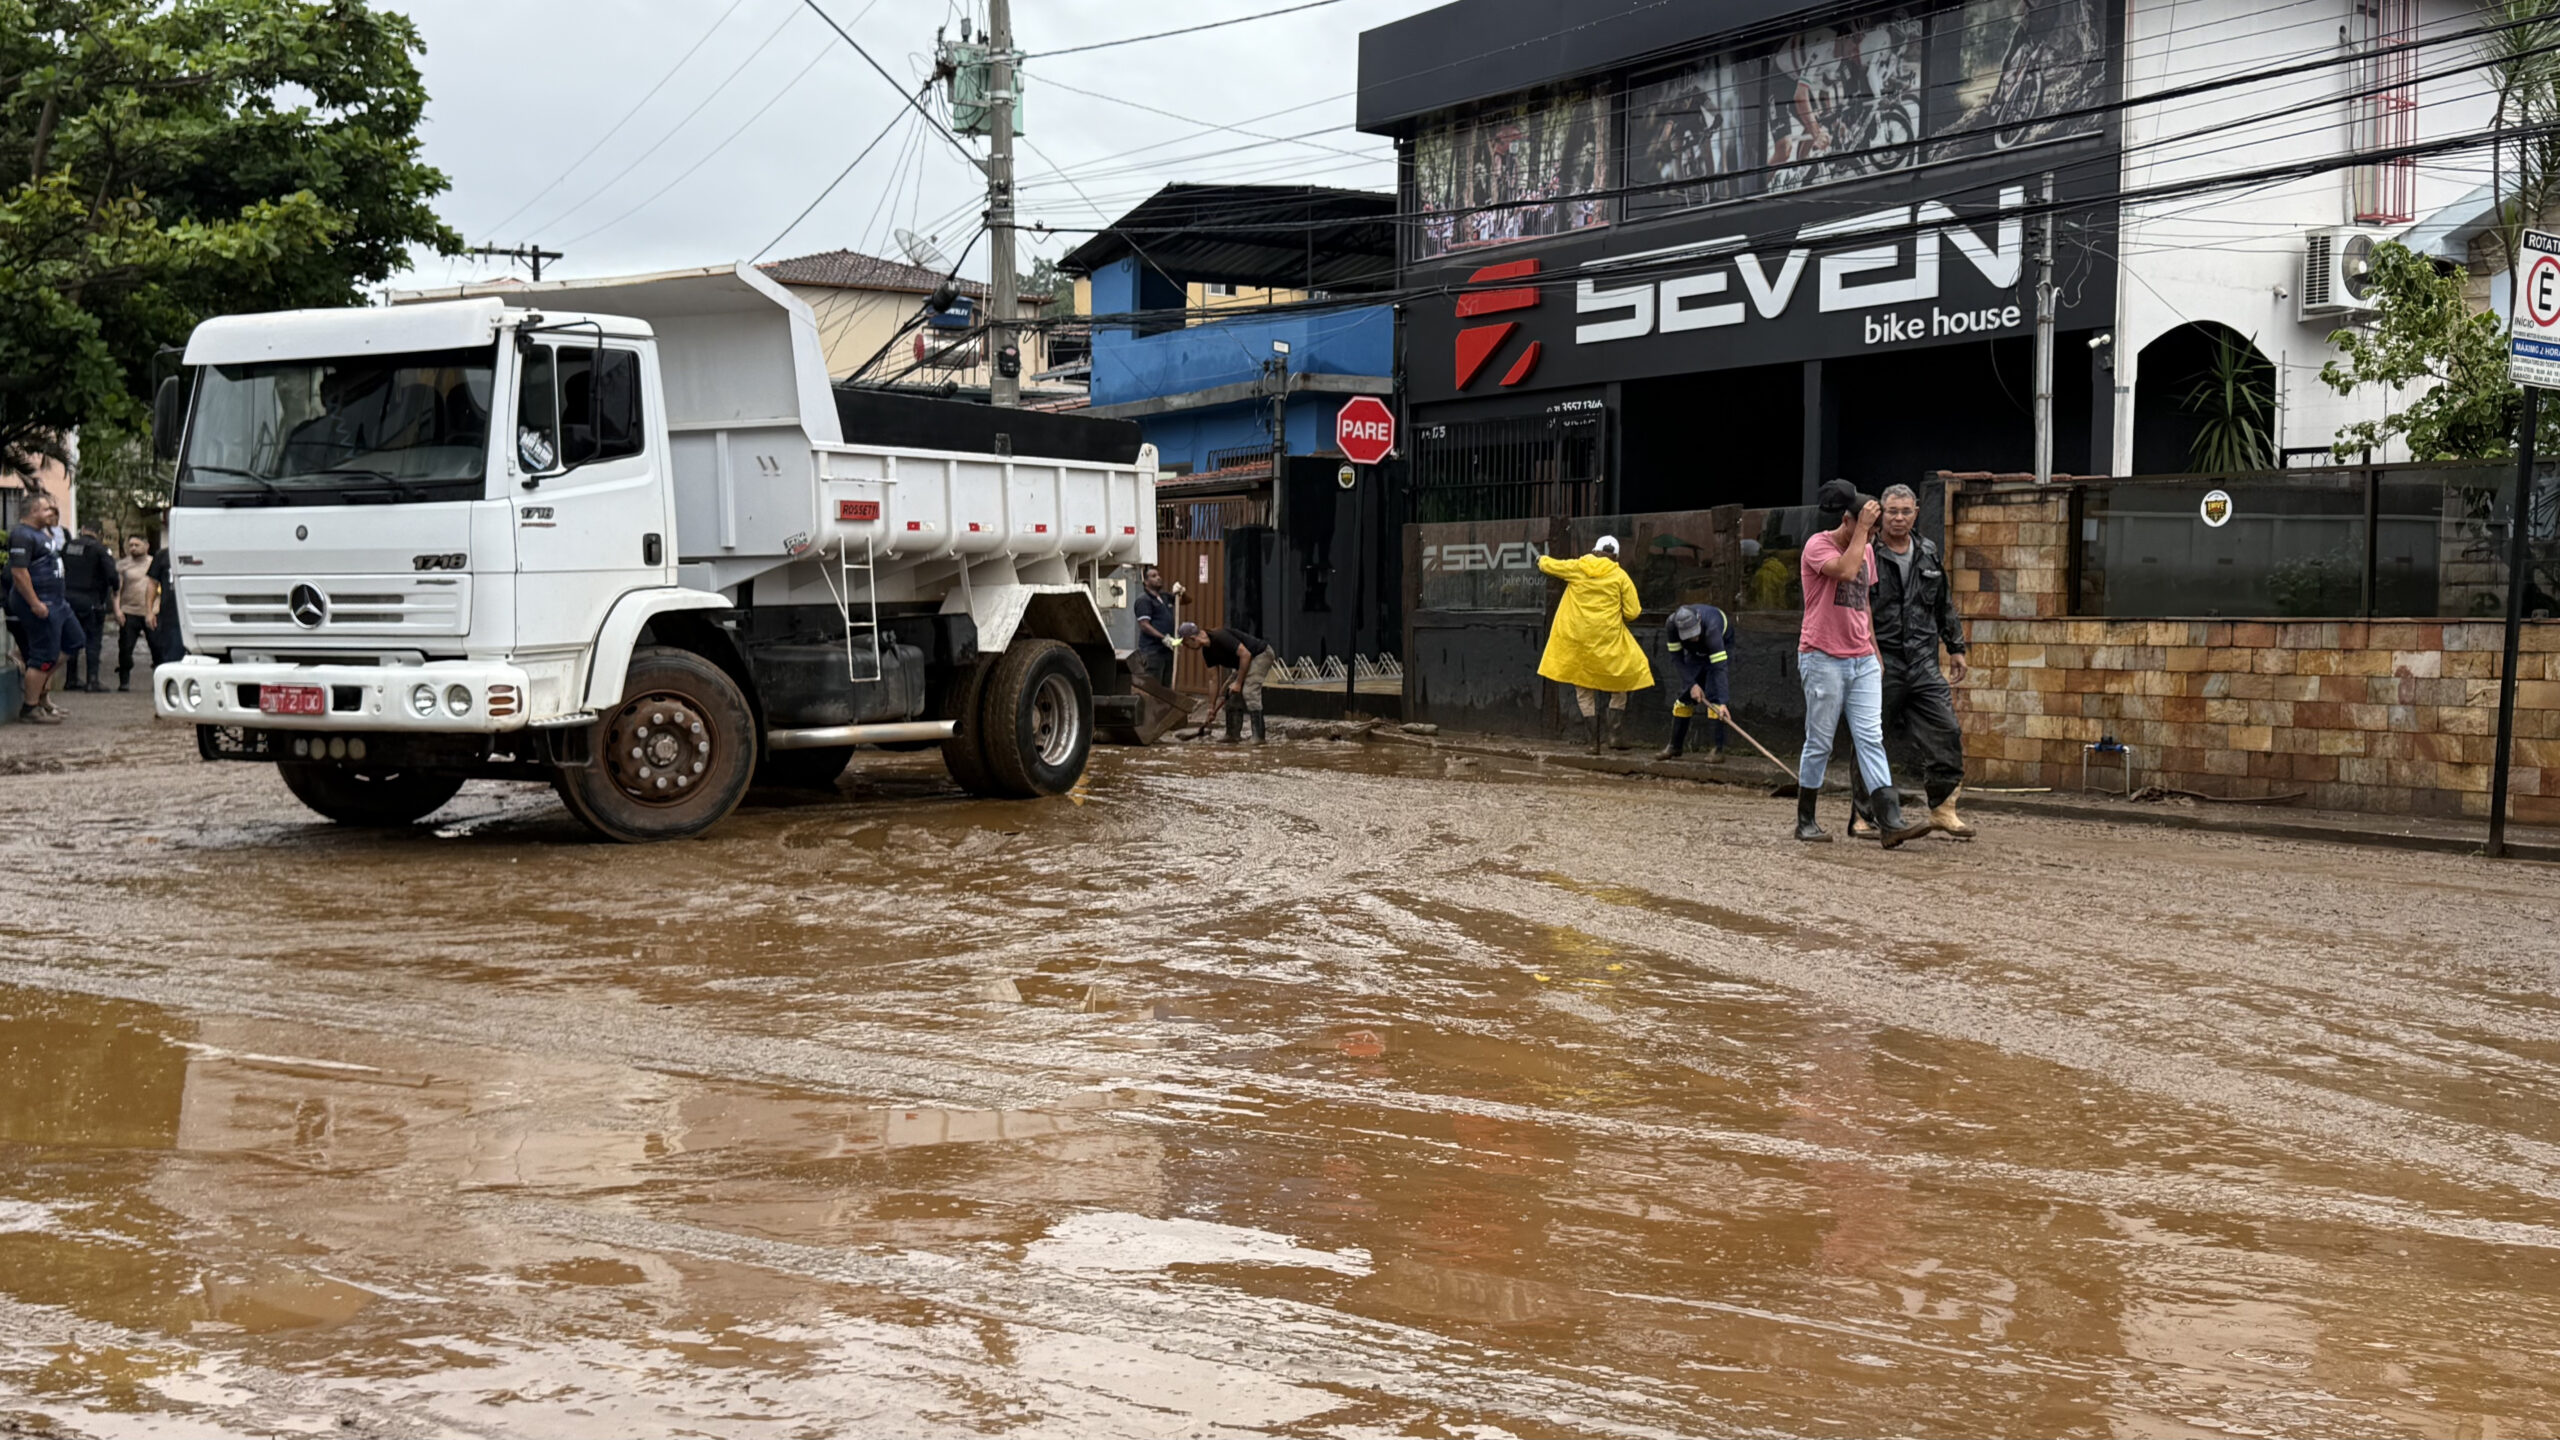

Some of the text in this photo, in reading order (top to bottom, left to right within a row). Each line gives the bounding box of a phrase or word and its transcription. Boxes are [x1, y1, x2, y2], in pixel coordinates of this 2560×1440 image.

[1576, 185, 2025, 344] SEVEN
[1865, 303, 2021, 345] bike house
[2515, 341, 2540, 354] MÁXIMO
[1342, 419, 1389, 442] PARE
[520, 506, 555, 520] 1718
[412, 553, 468, 571] 1718
[1442, 541, 1550, 571] SEVEN
[1502, 573, 1521, 586] bike
